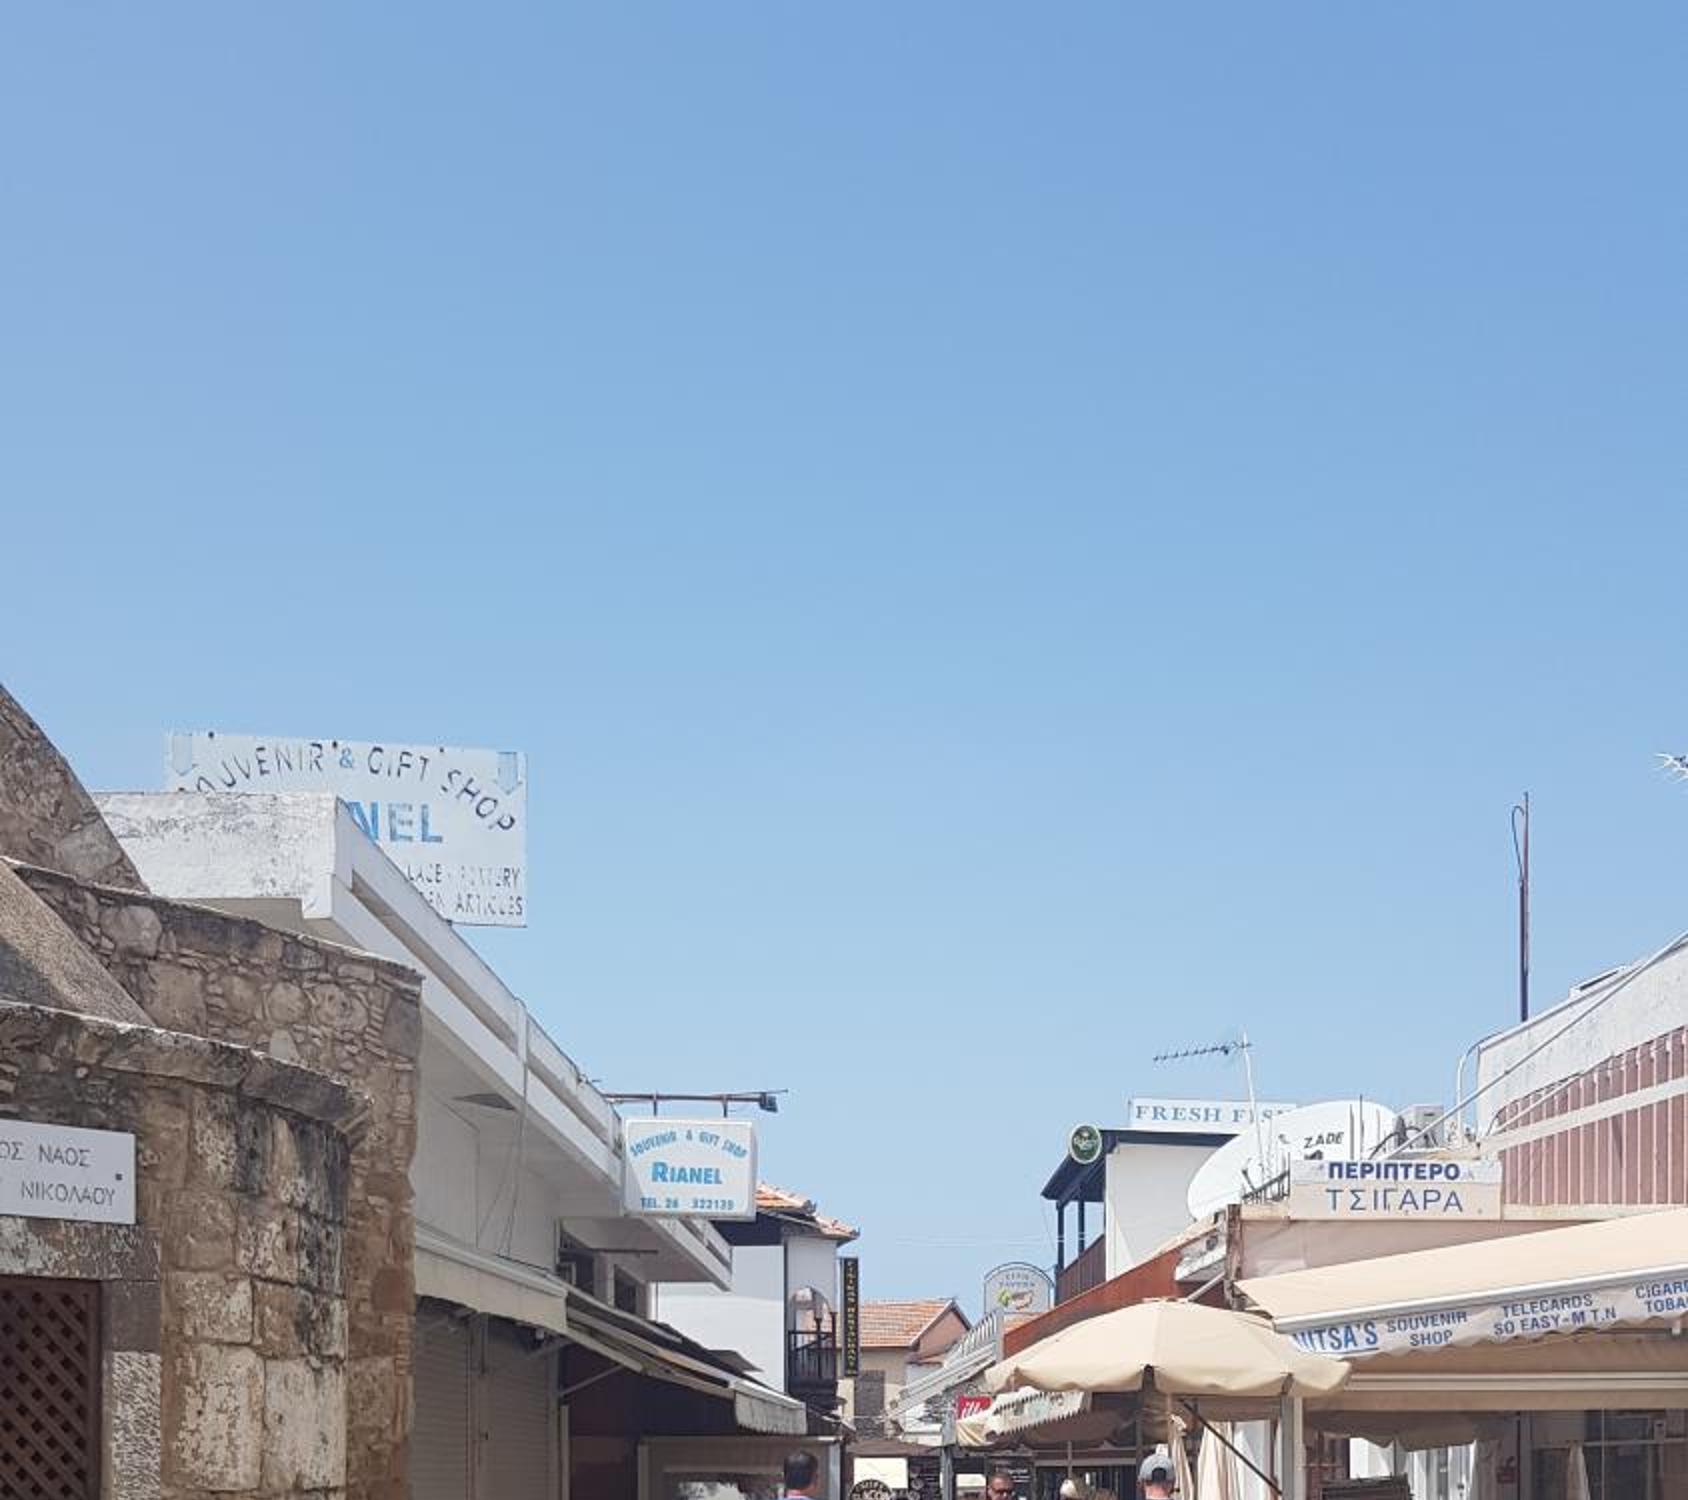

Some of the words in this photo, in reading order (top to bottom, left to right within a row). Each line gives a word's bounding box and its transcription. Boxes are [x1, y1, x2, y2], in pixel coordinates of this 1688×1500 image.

[195, 743, 323, 792] OUVENIR
[338, 747, 353, 769] &
[367, 746, 430, 781] GIFT
[440, 769, 515, 830] SHOP
[347, 801, 444, 843] NEL
[1136, 1104, 1220, 1123] FRESH
[38, 1144, 91, 1168] ΝΑΟΣ
[651, 1161, 723, 1185] RIANEL
[1328, 1161, 1462, 1182] ΠΕΡΙΠΤΕΡΟ
[21, 1180, 115, 1206] ΝΙΚΟΛΑΟΥ
[1326, 1187, 1464, 1213] ΤΣΙΓΑΡΑ
[1502, 1293, 1593, 1319] TELECARDS
[1644, 1296, 1688, 1313] TOBA
[1386, 1310, 1469, 1333] SOUVENIR
[1409, 1329, 1453, 1347] SHOP
